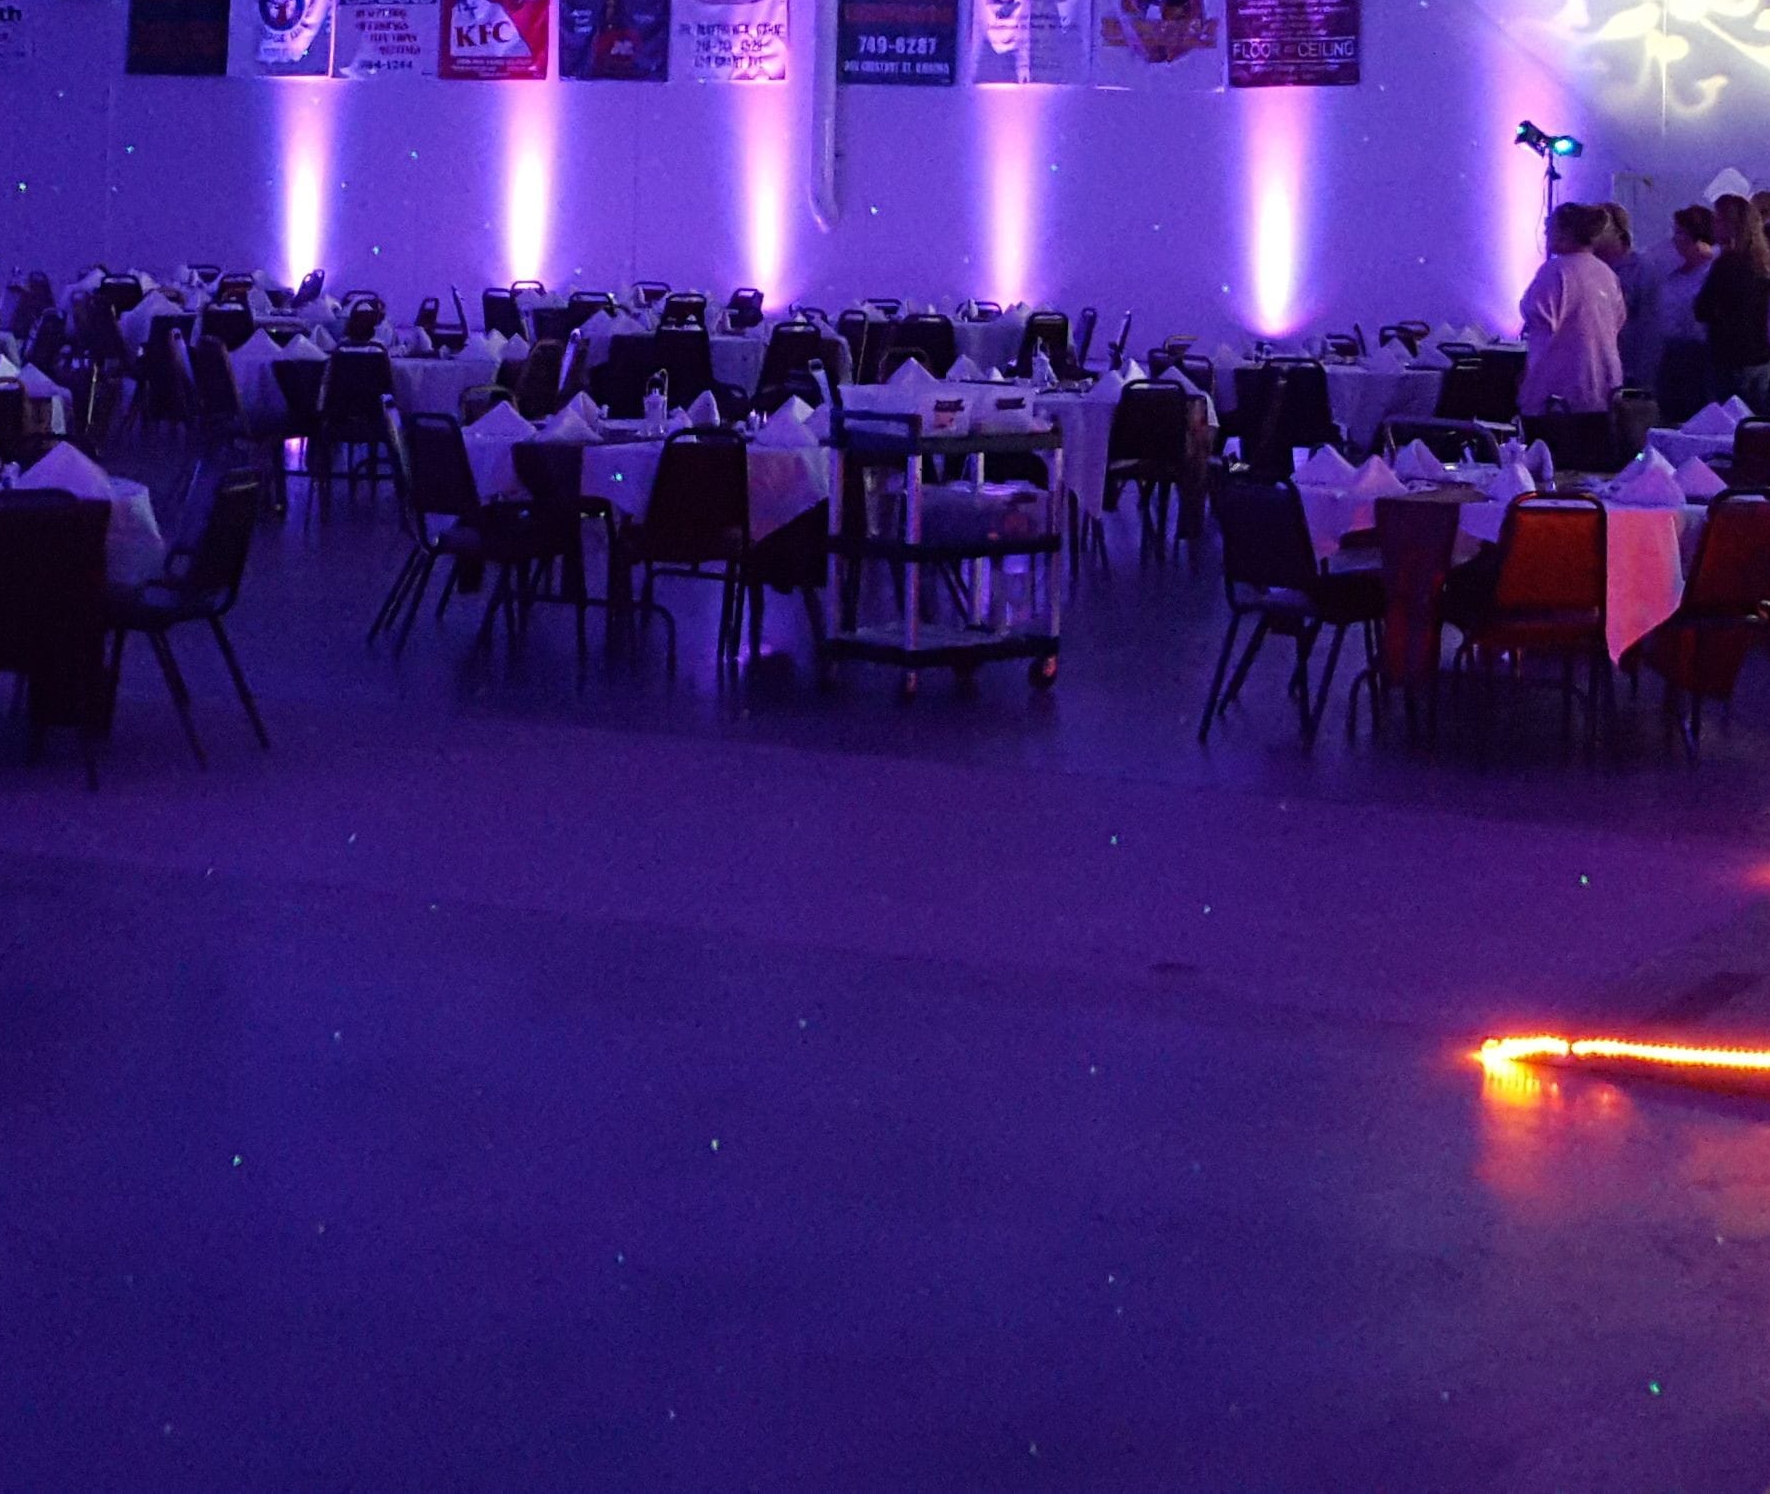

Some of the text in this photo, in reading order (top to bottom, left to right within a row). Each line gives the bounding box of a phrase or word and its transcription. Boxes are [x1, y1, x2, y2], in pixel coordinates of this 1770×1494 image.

[454, 21, 512, 47] KFC
[858, 36, 938, 55] 749-6287
[1232, 41, 1281, 58] FLOOR
